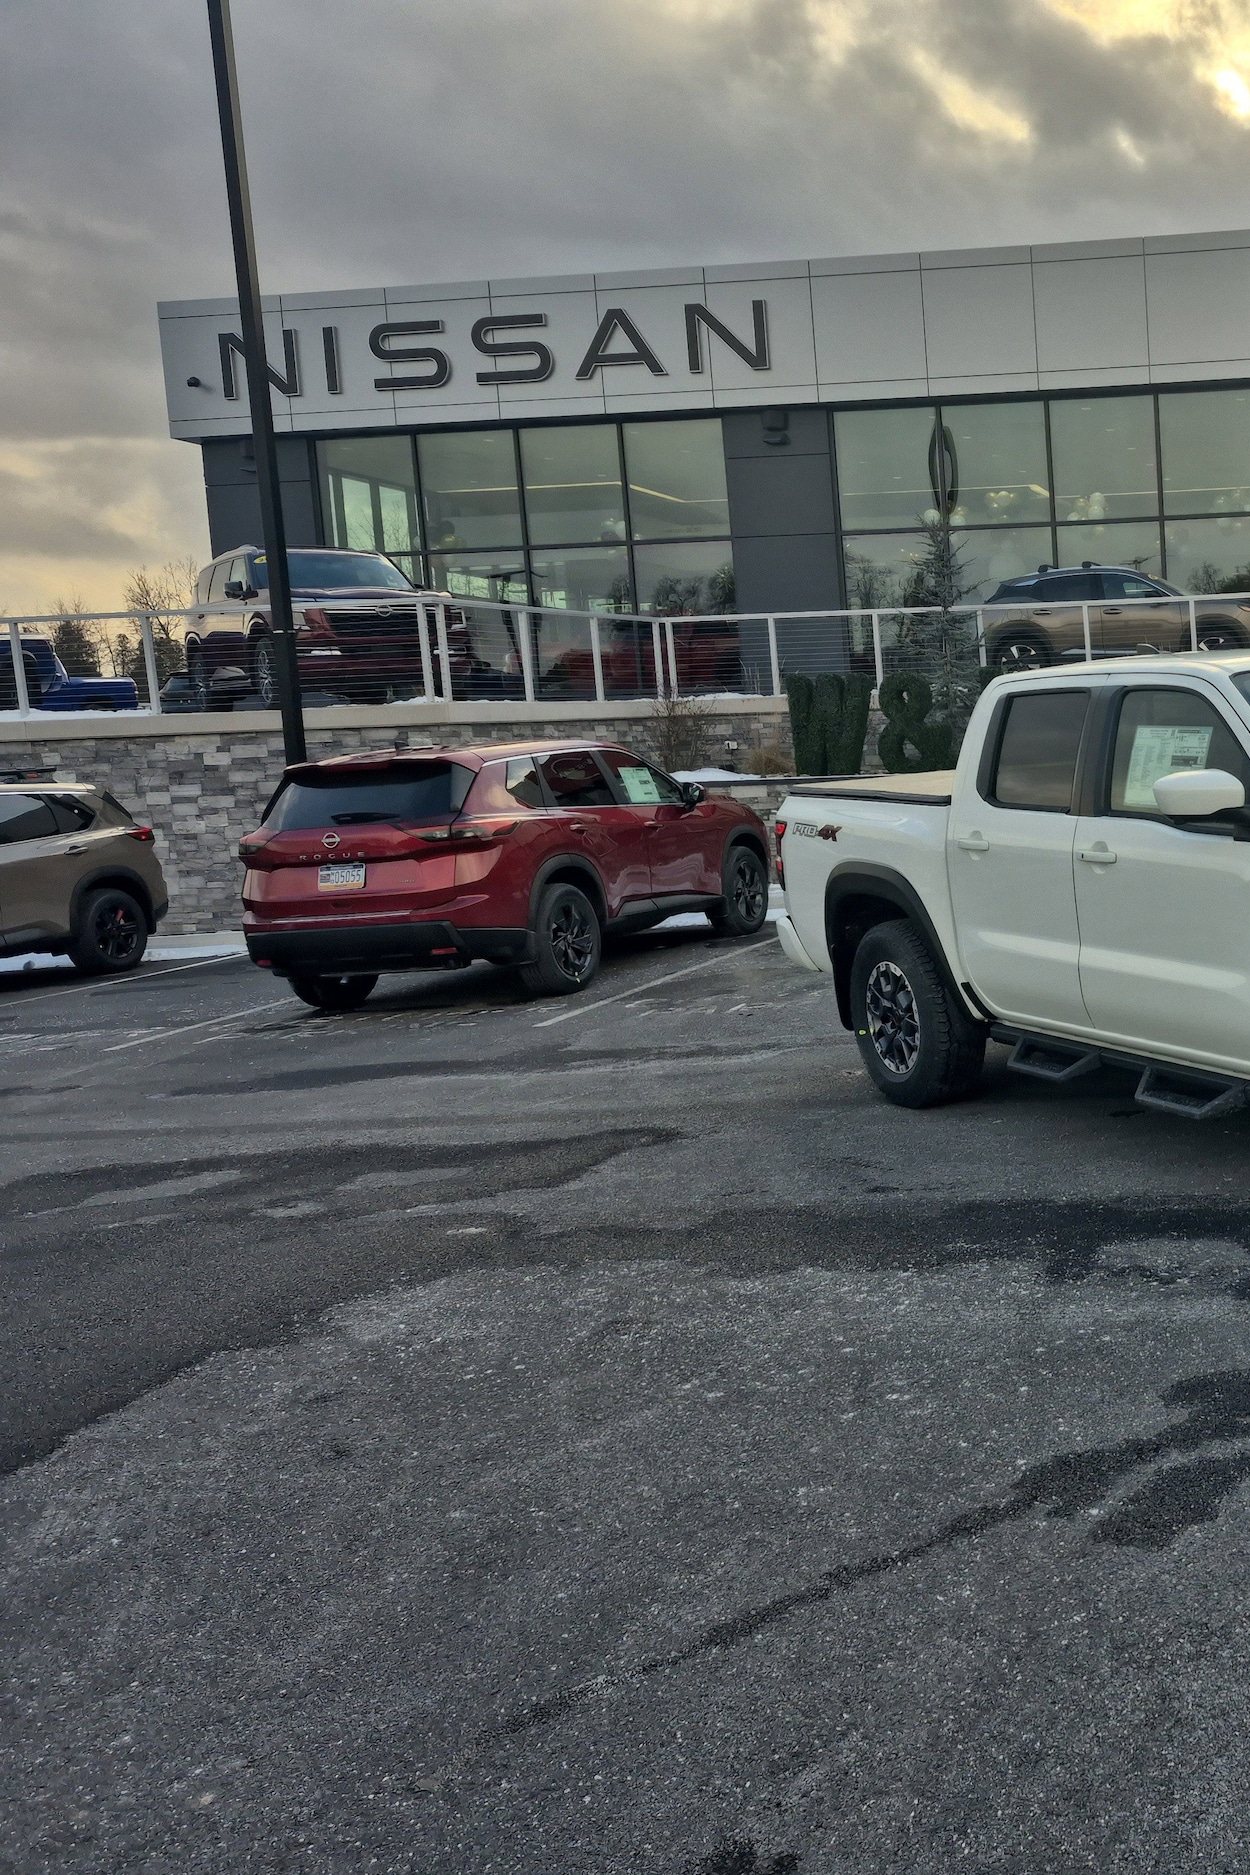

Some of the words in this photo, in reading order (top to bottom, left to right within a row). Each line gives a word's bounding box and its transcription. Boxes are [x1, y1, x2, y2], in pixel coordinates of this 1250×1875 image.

[217, 299, 770, 400] NISSAN
[299, 852, 365, 860] ROGUE
[334, 870, 361, 883] 05055
